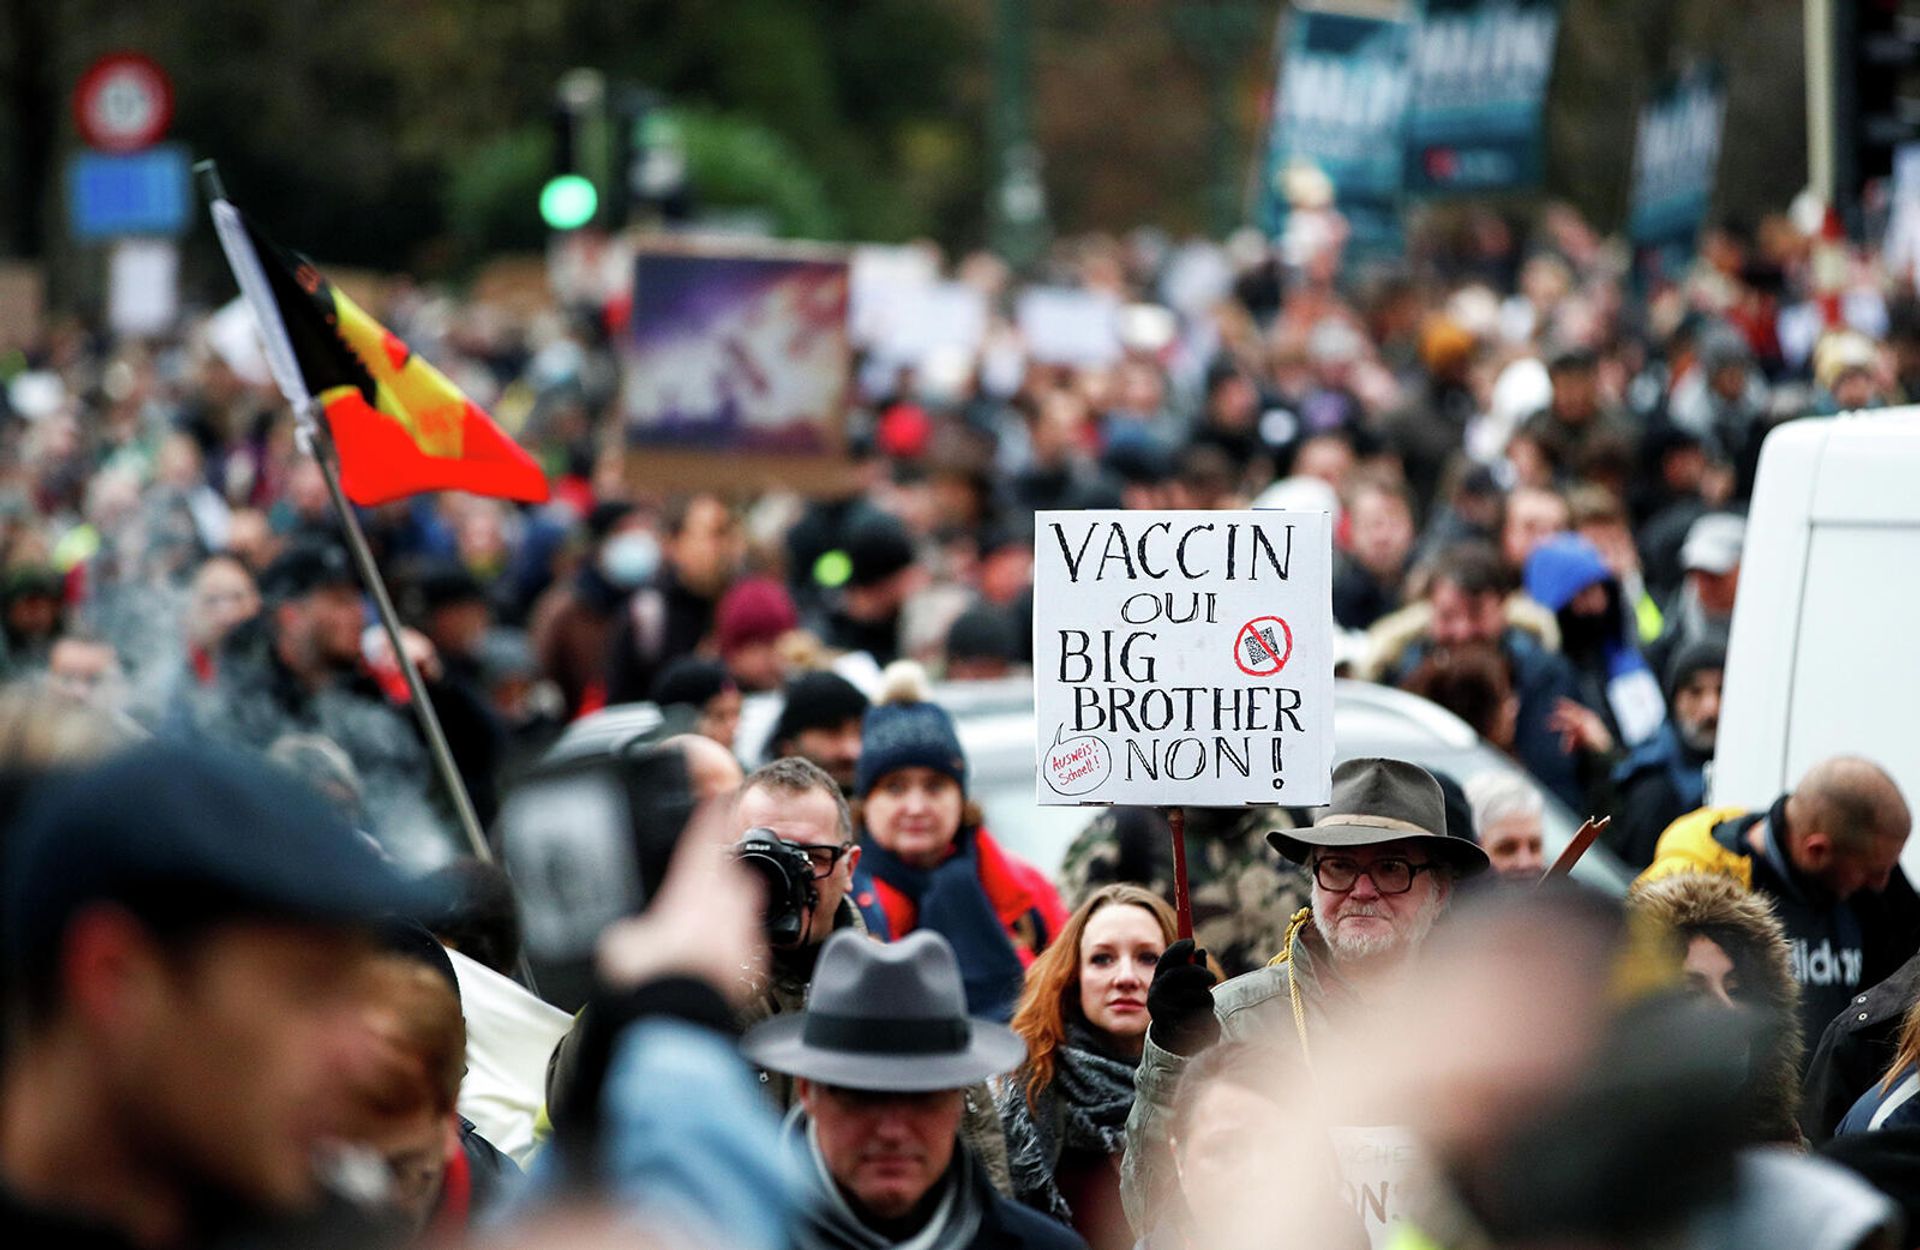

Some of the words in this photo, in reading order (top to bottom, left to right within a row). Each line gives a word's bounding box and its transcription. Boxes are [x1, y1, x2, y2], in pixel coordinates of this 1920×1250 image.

[1048, 522, 1297, 583] VACCIN
[1120, 592, 1218, 624] OUI
[1057, 630, 1158, 683] BIG
[1069, 686, 1306, 733] BROTHER
